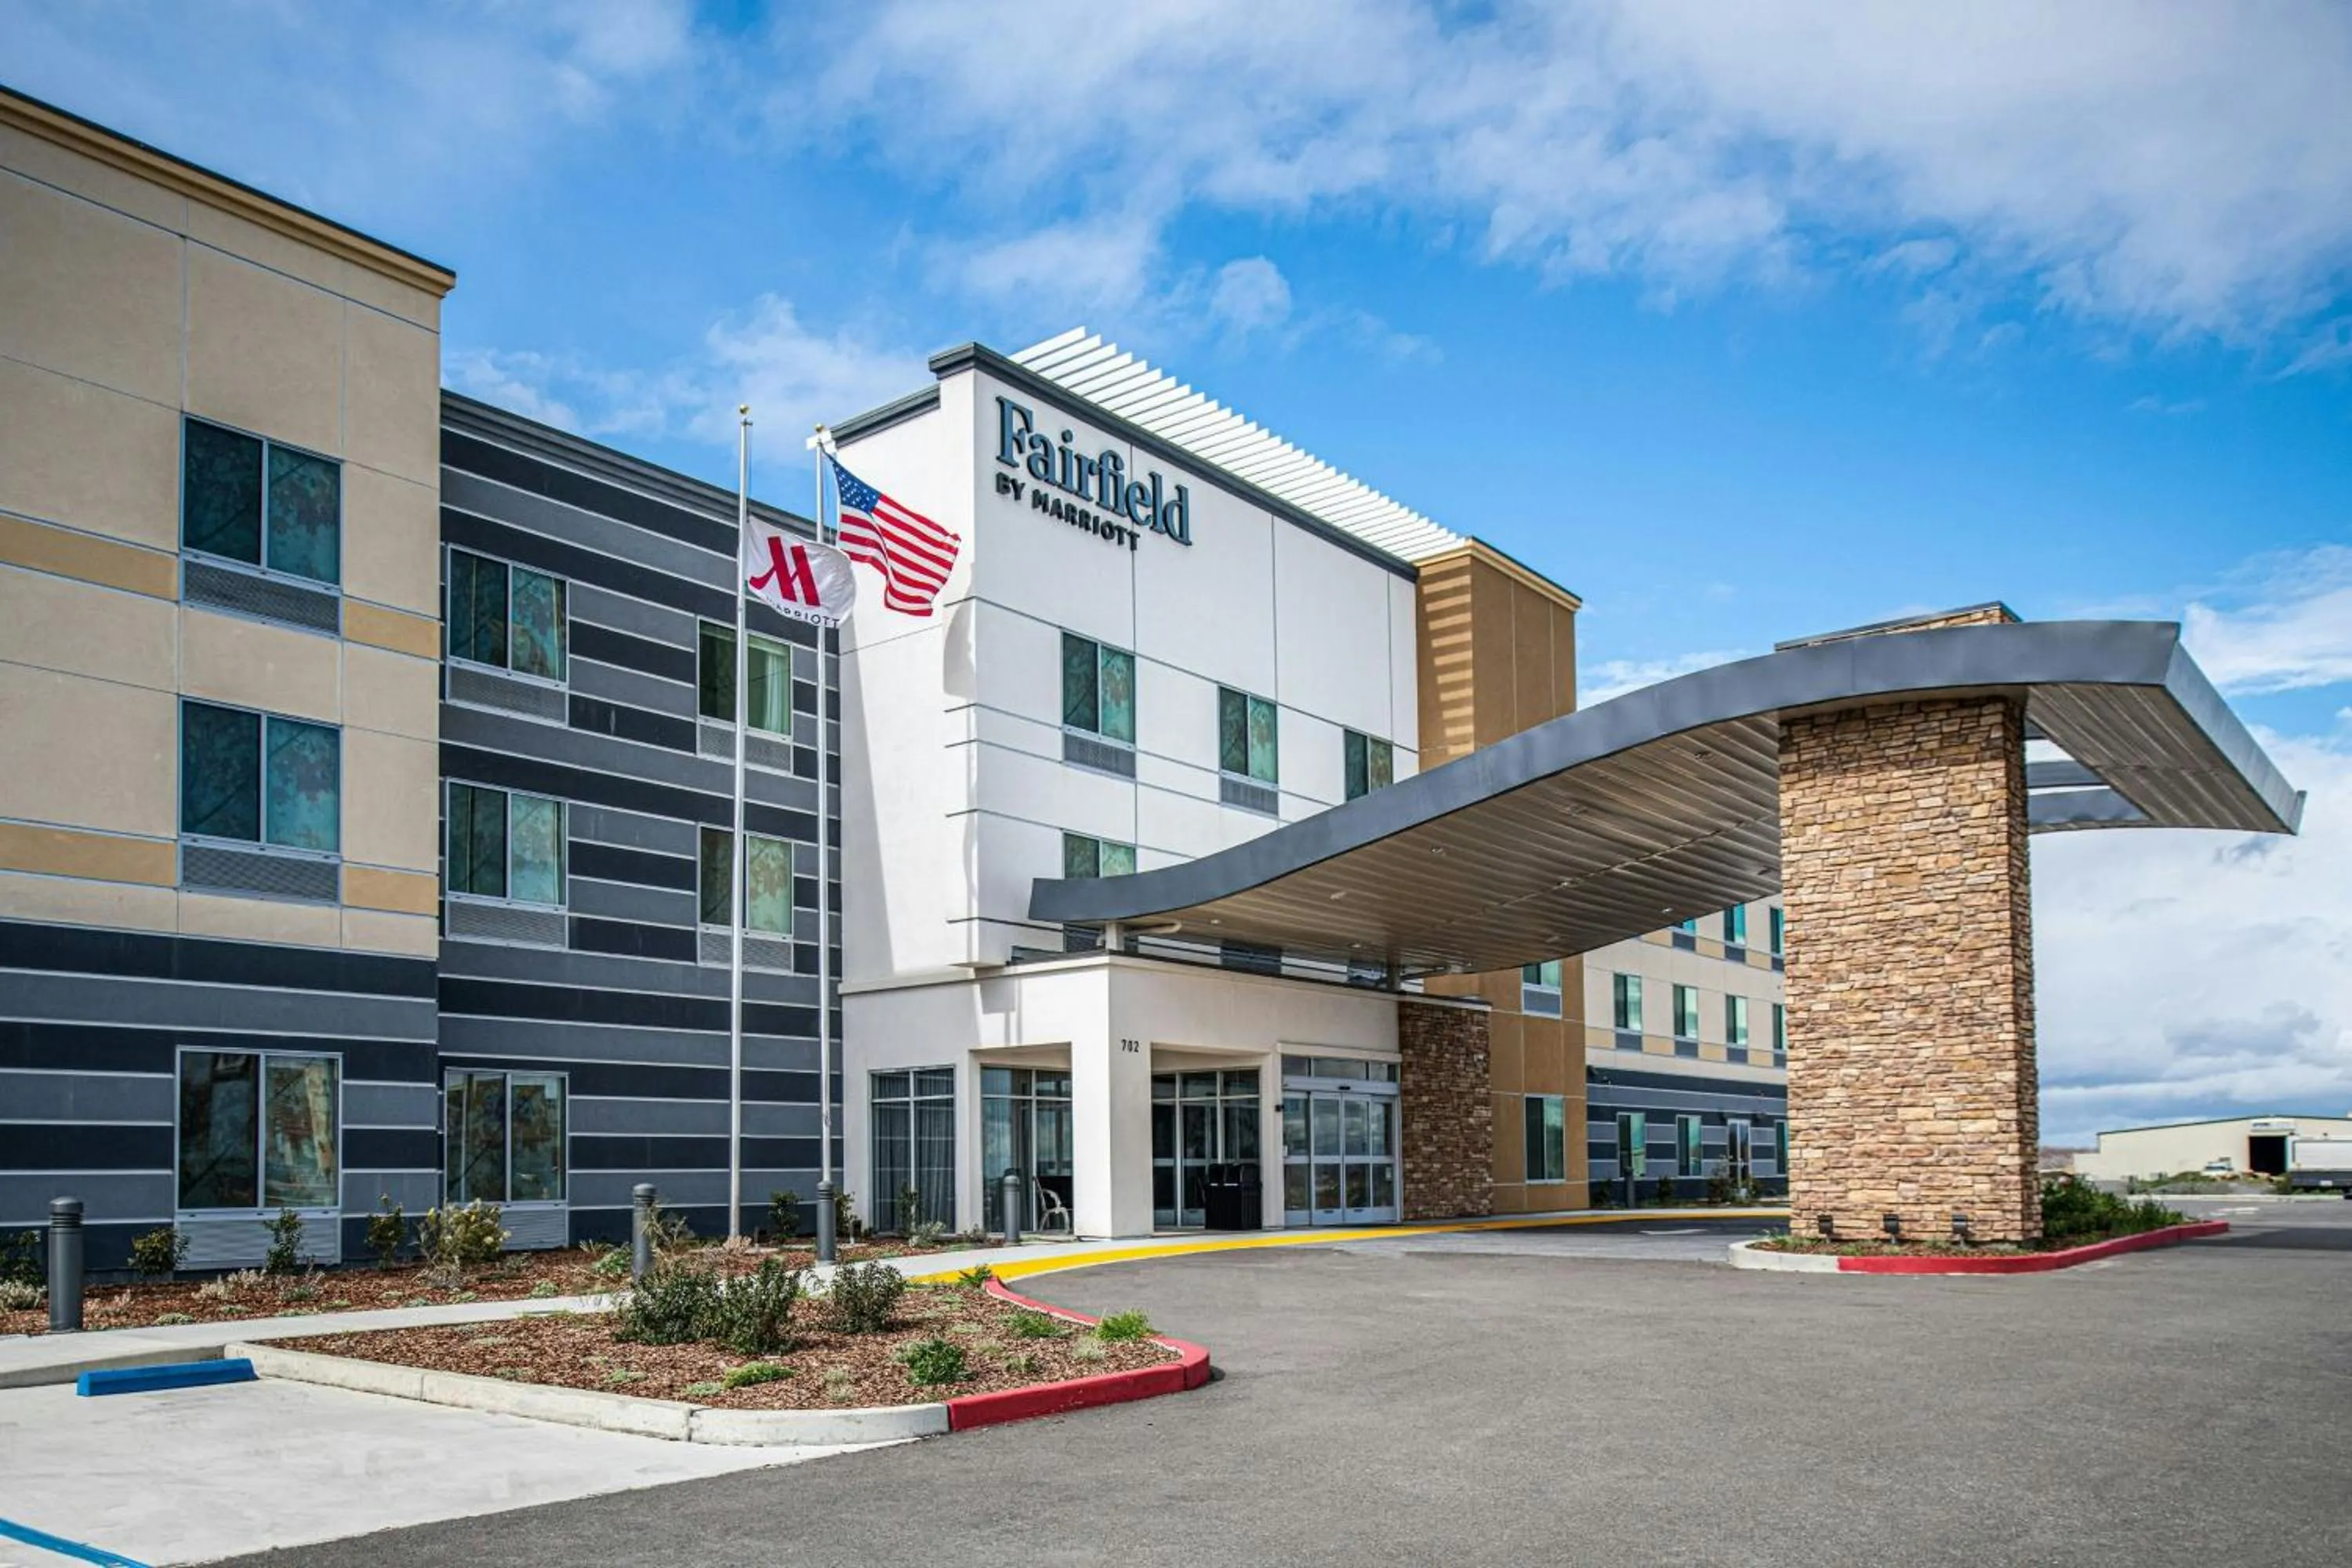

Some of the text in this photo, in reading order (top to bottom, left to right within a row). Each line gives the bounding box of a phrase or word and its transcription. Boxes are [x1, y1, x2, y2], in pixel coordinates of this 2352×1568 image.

[996, 395, 1192, 546] Fairfield
[996, 472, 1140, 550] BY MARRIOTT
[766, 597, 840, 627] ARRIOTT
[1121, 1039, 1139, 1053] 702
